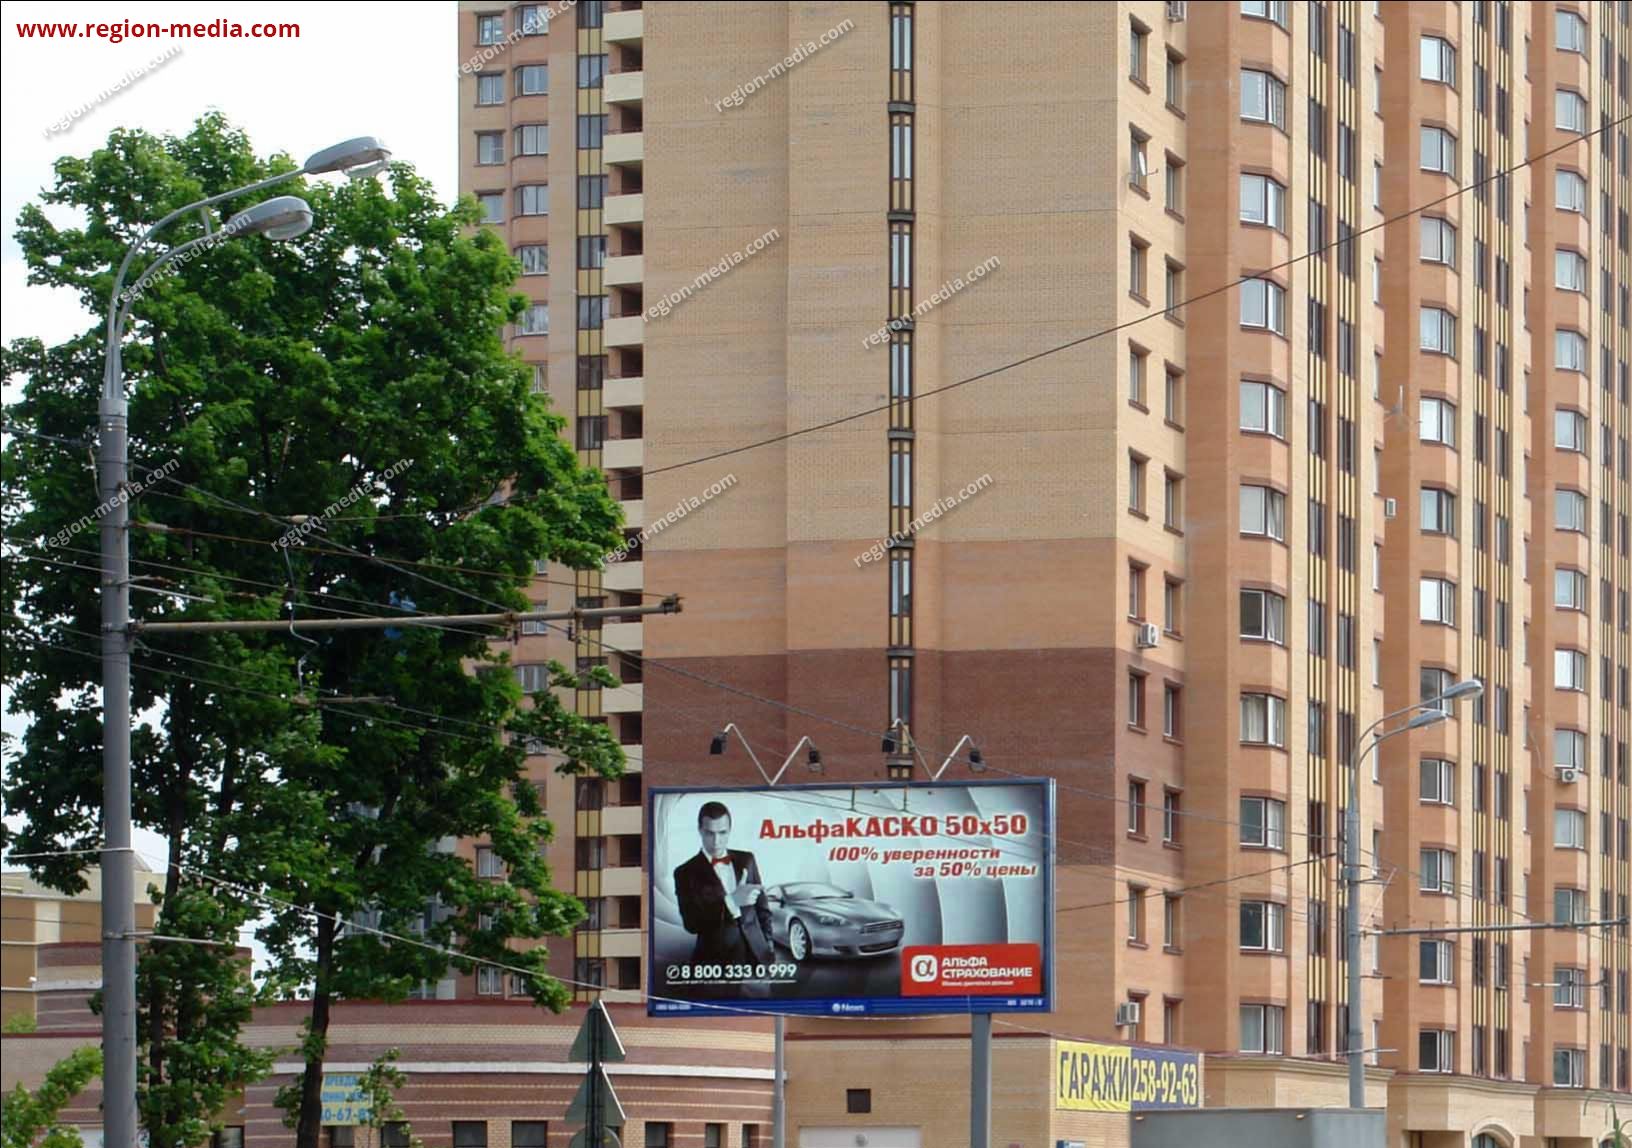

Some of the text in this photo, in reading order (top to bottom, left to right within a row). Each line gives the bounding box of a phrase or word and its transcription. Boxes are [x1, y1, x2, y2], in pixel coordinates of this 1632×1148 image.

[759, 816, 938, 843] АльфаКАСКО
[829, 847, 1001, 864] 100% уверенности
[914, 862, 1037, 877] за 50% цены
[941, 956, 988, 967] АЛЬФА
[681, 964, 797, 978] 8 800 333 0 999
[941, 967, 1033, 978] СТРАХОВАНИЕ
[1059, 1051, 1130, 1102] ГАРАЖИ
[1132, 1058, 1197, 1105] 258-92-63
